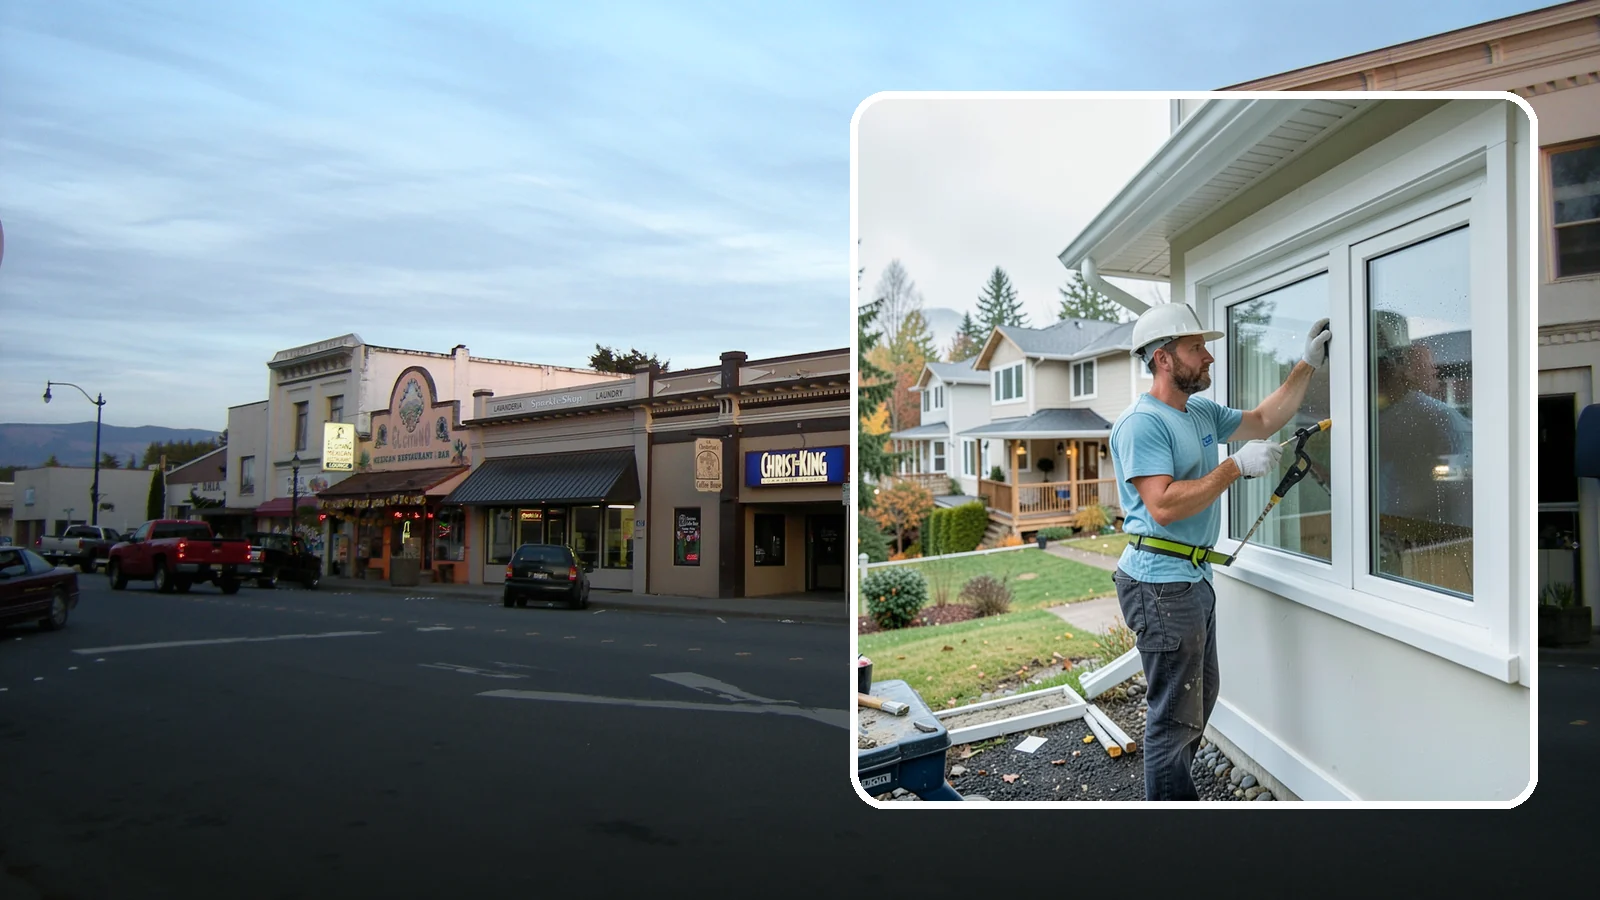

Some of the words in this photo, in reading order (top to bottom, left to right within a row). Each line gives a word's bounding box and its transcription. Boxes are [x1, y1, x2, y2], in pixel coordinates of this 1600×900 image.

[493, 402, 523, 413] LAVANDERIA
[595, 389, 624, 400] LAUNDRY
[373, 455, 396, 464] MEXICAN
[397, 451, 433, 462] RESTAURANT
[437, 450, 450, 459] BAR
[760, 452, 797, 478] CHRIST
[799, 450, 828, 476] KING
